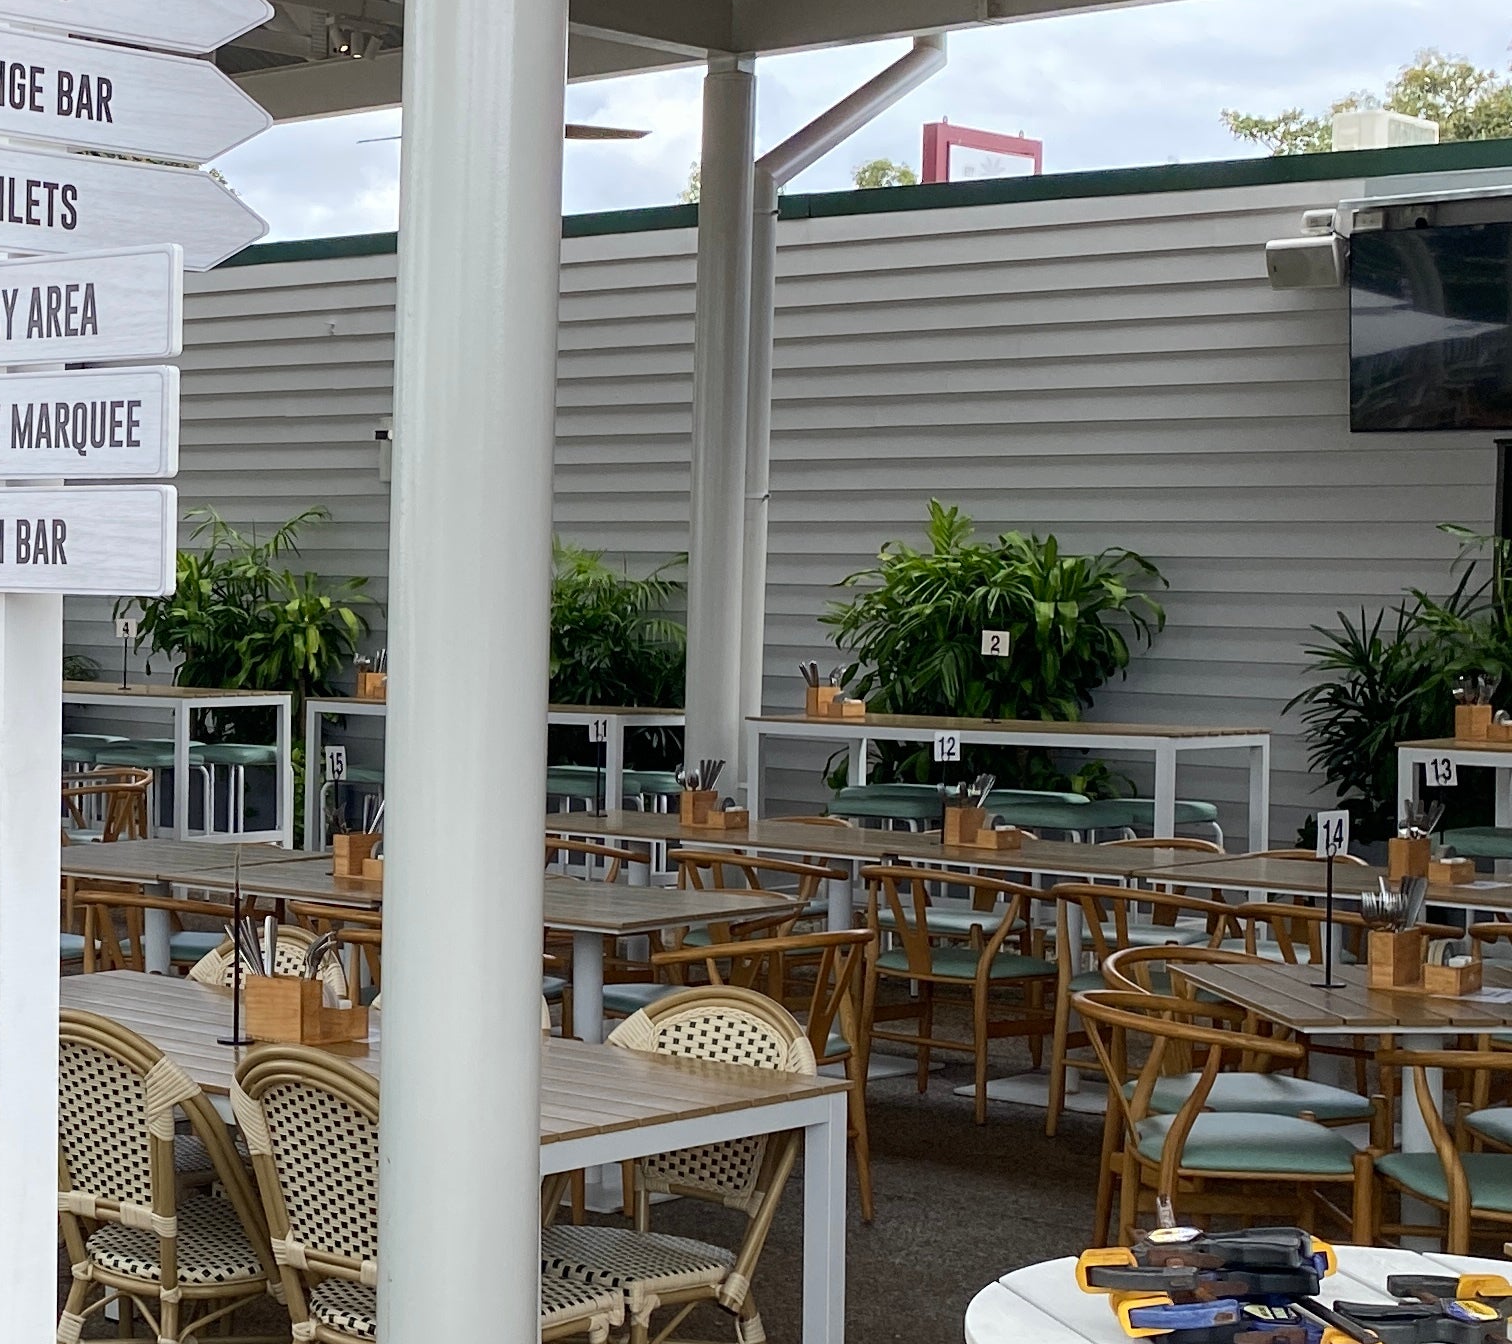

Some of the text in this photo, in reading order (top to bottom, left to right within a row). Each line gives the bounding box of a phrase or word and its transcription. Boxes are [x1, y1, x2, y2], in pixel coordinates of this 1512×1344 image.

[56, 70, 113, 124] BAR
[26, 282, 98, 339] AREA
[10, 399, 142, 457] MARQUEE
[16, 518, 68, 565] BAR
[122, 621, 130, 635] 4
[990, 635, 1000, 652] 2
[593, 719, 607, 738] 11
[938, 736, 956, 756] 12
[329, 752, 344, 775] 15
[1430, 758, 1452, 781] 13
[1322, 818, 1344, 850] 14
